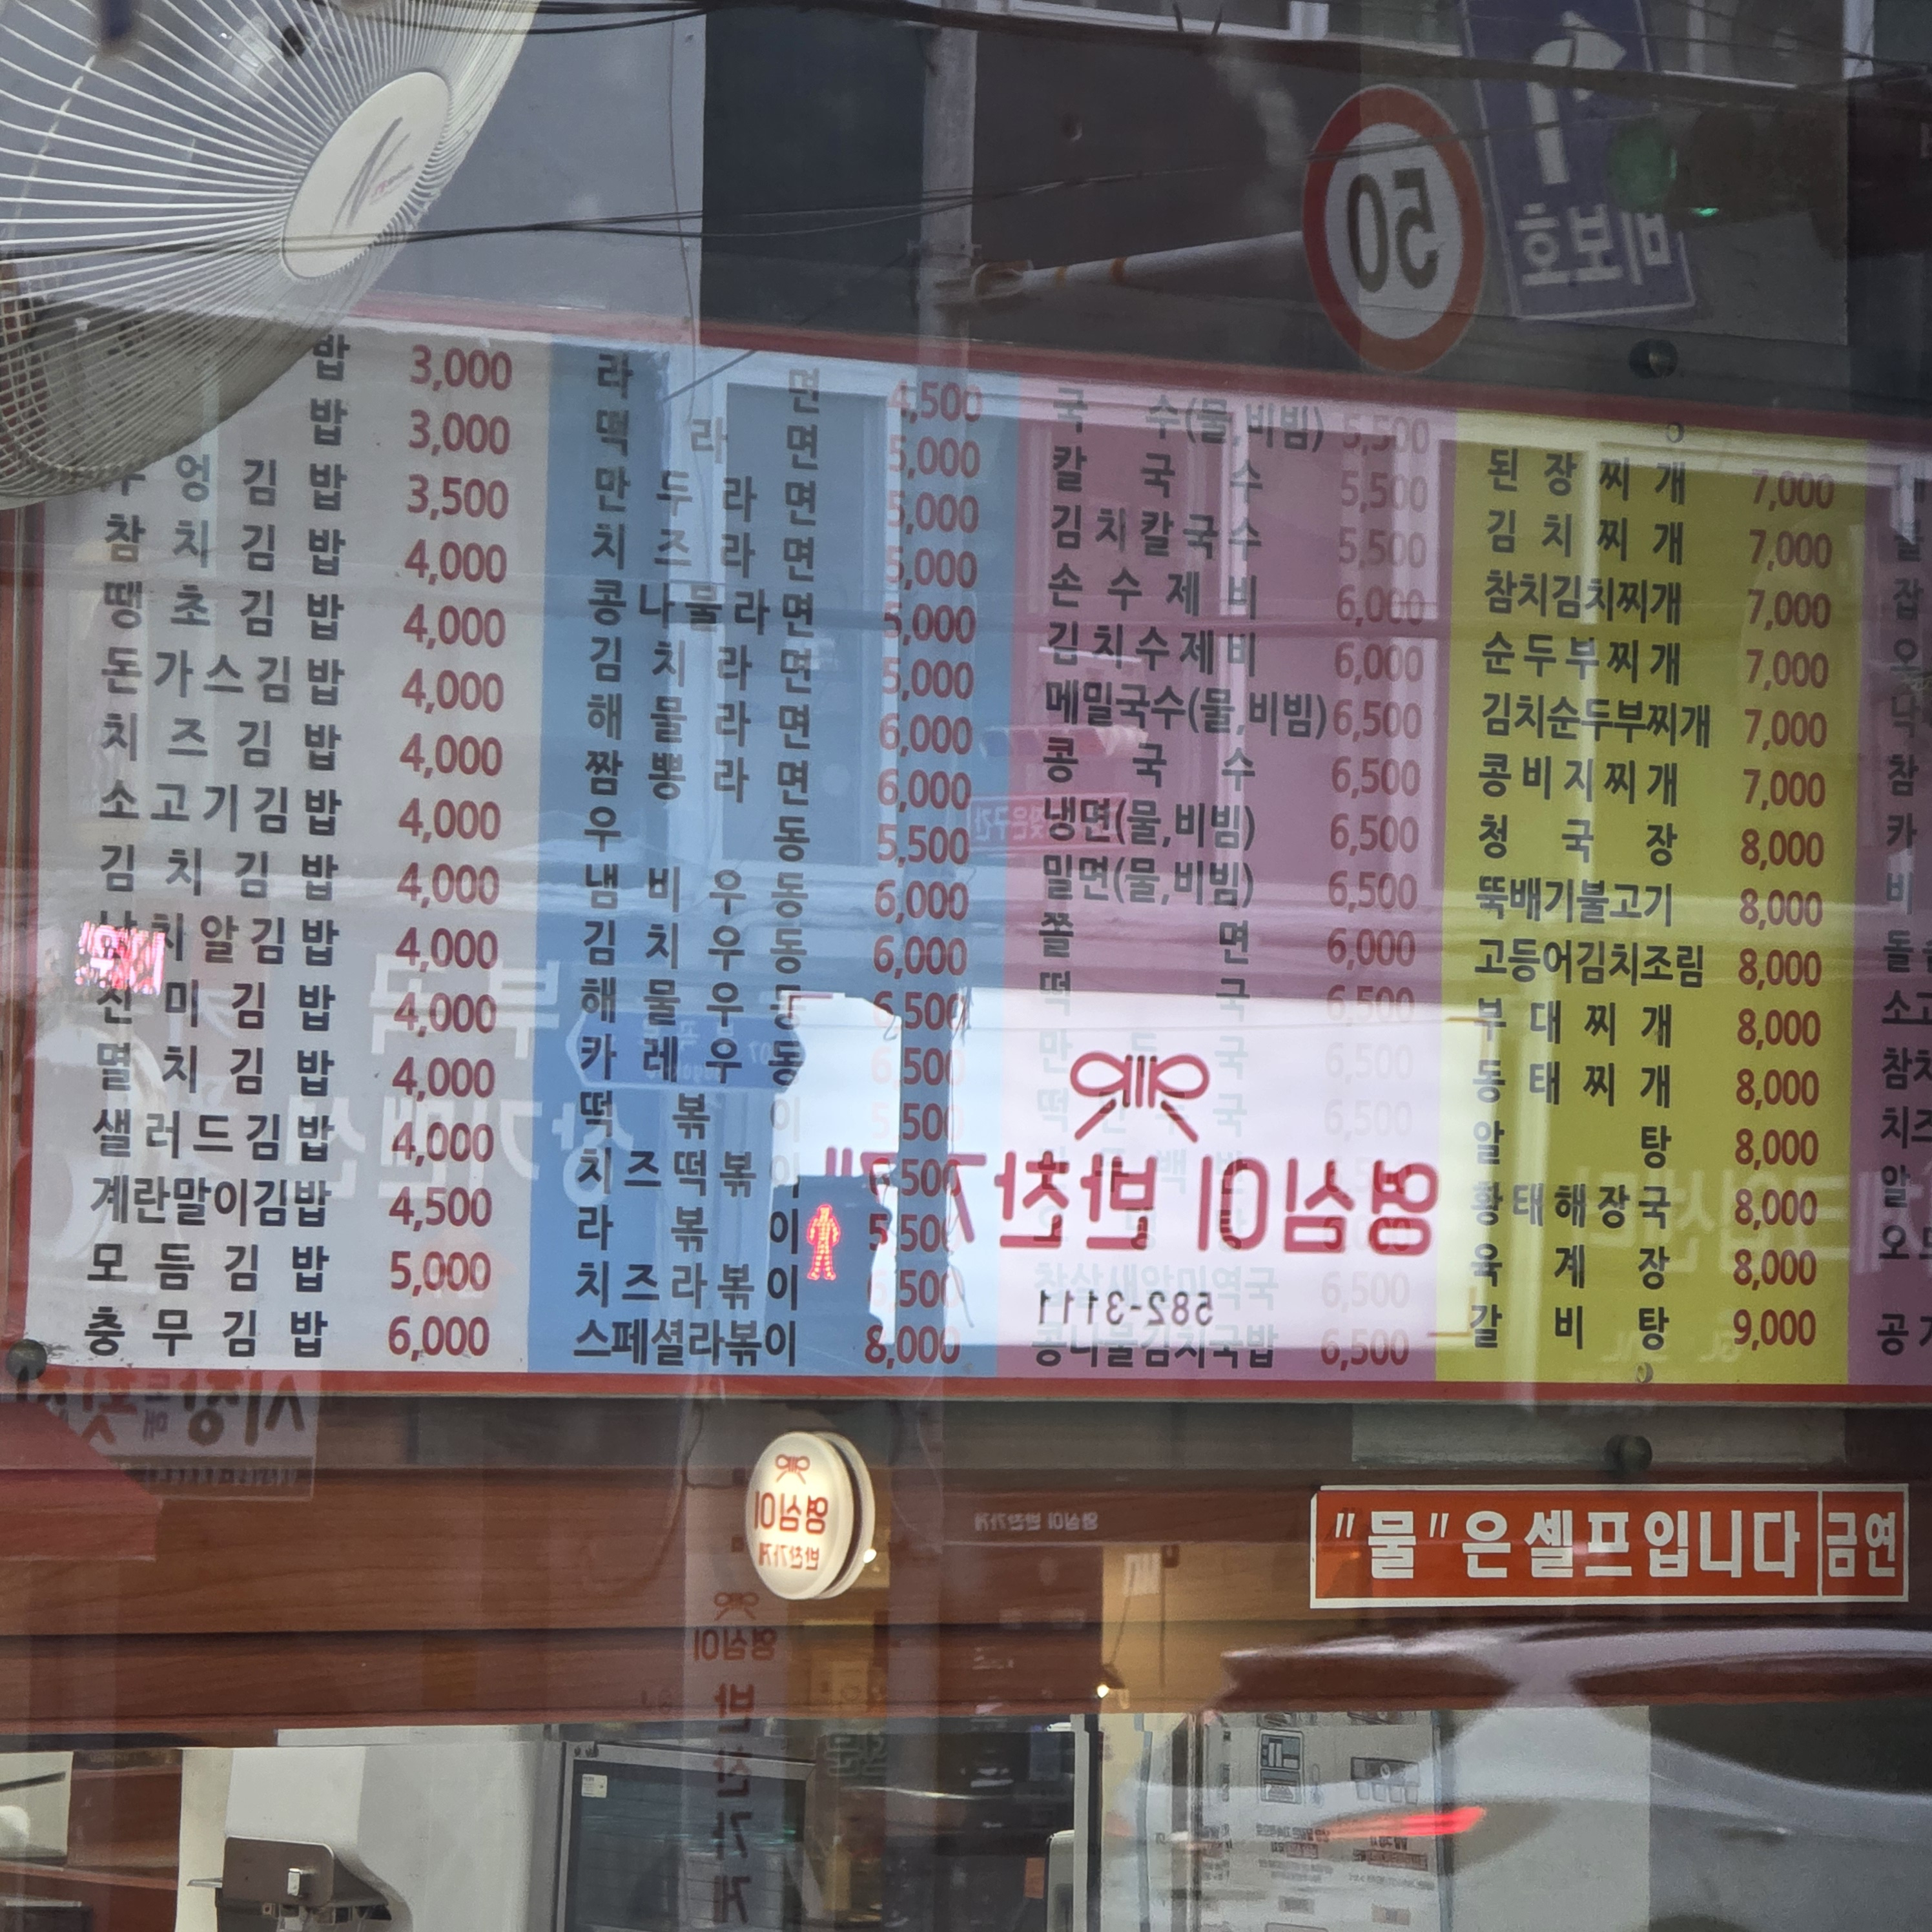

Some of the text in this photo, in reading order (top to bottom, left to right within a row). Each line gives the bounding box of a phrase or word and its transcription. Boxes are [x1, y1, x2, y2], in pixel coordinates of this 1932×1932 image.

[410, 345, 513, 390] 3,000
[887, 378, 983, 425] 4,500
[407, 409, 510, 455] 3,000
[596, 408, 981, 480] 떡라면 5,000
[406, 474, 509, 519] 3,500
[595, 466, 979, 535] 만두라면 5,000
[1053, 446, 1428, 513] 칼국수 5,500
[1488, 449, 1685, 504] 된장찌개
[1751, 469, 1835, 511] 7,000
[104, 513, 508, 585] 참치김밥 4,000
[591, 524, 978, 590] 치즈라면 5,000
[1051, 505, 1426, 570] 김치칼국수 5,500
[1487, 509, 1833, 571] 김치찌개 7,000
[103, 581, 506, 649] 땡초김밥 4,000
[588, 580, 976, 646] 콩나물라면 5,000
[1048, 563, 1424, 627] 손수제비 6,000
[1485, 570, 1831, 630] 참치김치찌개 7,000
[101, 646, 504, 714] 돈가스김밥 4,000
[590, 637, 975, 701] 김치라면 5,000
[1048, 621, 1423, 684] 김치수제비 6,000
[1483, 632, 1829, 691] 순두부찌개 7,000
[102, 713, 502, 779] 치즈김밥 4,000
[587, 693, 974, 757] 해물라면 6,000
[1333, 699, 1422, 742] 6,500
[1483, 693, 1827, 750] 김치순두부찌개 7,000
[585, 750, 972, 813] 짬뽕라면 6,000
[1043, 737, 1421, 799] 콩국수 6,500
[1479, 754, 1825, 810] 콩비지찌개 7,000
[98, 780, 501, 841] 소고기김밥 4,000
[584, 807, 970, 867] 우동 5,500
[1330, 812, 1419, 857] 6,500
[1478, 814, 1824, 870] 청국장 8,000
[99, 844, 500, 909] 김치김밥 4,000
[585, 863, 969, 923] 냄비우동 6,000
[1329, 870, 1417, 914] 6,500
[1476, 876, 1823, 930] 뚝배기불고기 8,000
[395, 928, 498, 972] 4,000
[583, 919, 967, 978] 김치우동 6,000
[1328, 928, 1416, 971] 6,000
[1475, 939, 1822, 990] 고등어김치조림 8,000
[393, 992, 497, 1038] 4,000
[581, 976, 806, 1031] 해물우동
[1474, 998, 1821, 1050] 부대찌개 8,000
[97, 1042, 495, 1102] 멸치김밥 4,000
[581, 1034, 803, 1087] 카레우동
[1473, 1060, 1820, 1110] 동태찌개 8,000
[92, 1107, 495, 1167] 샐러드김밥 4,000
[1473, 1121, 1818, 1171] 알탕 8,000
[578, 1149, 801, 1199] 치즈떡볶이
[91, 1175, 492, 1232] 계란말이김밥 4,500
[577, 1205, 799, 1255] 라볶이
[1471, 1182, 1817, 1230] 황태해장국 8,000
[87, 1242, 491, 1296] 모듬김밥 5,000
[576, 1261, 799, 1311] 치즈라볶이
[1470, 1244, 1816, 1290] 육계장 8,000
[84, 1306, 490, 1361] 충무김밥 6,000
[573, 1318, 960, 1370] 스페셜라볶이 8,000
[1470, 1304, 1669, 1351] 갈비탕
[1733, 1309, 1816, 1351] 9,000
[1826, 1512, 1896, 1579] 금연
